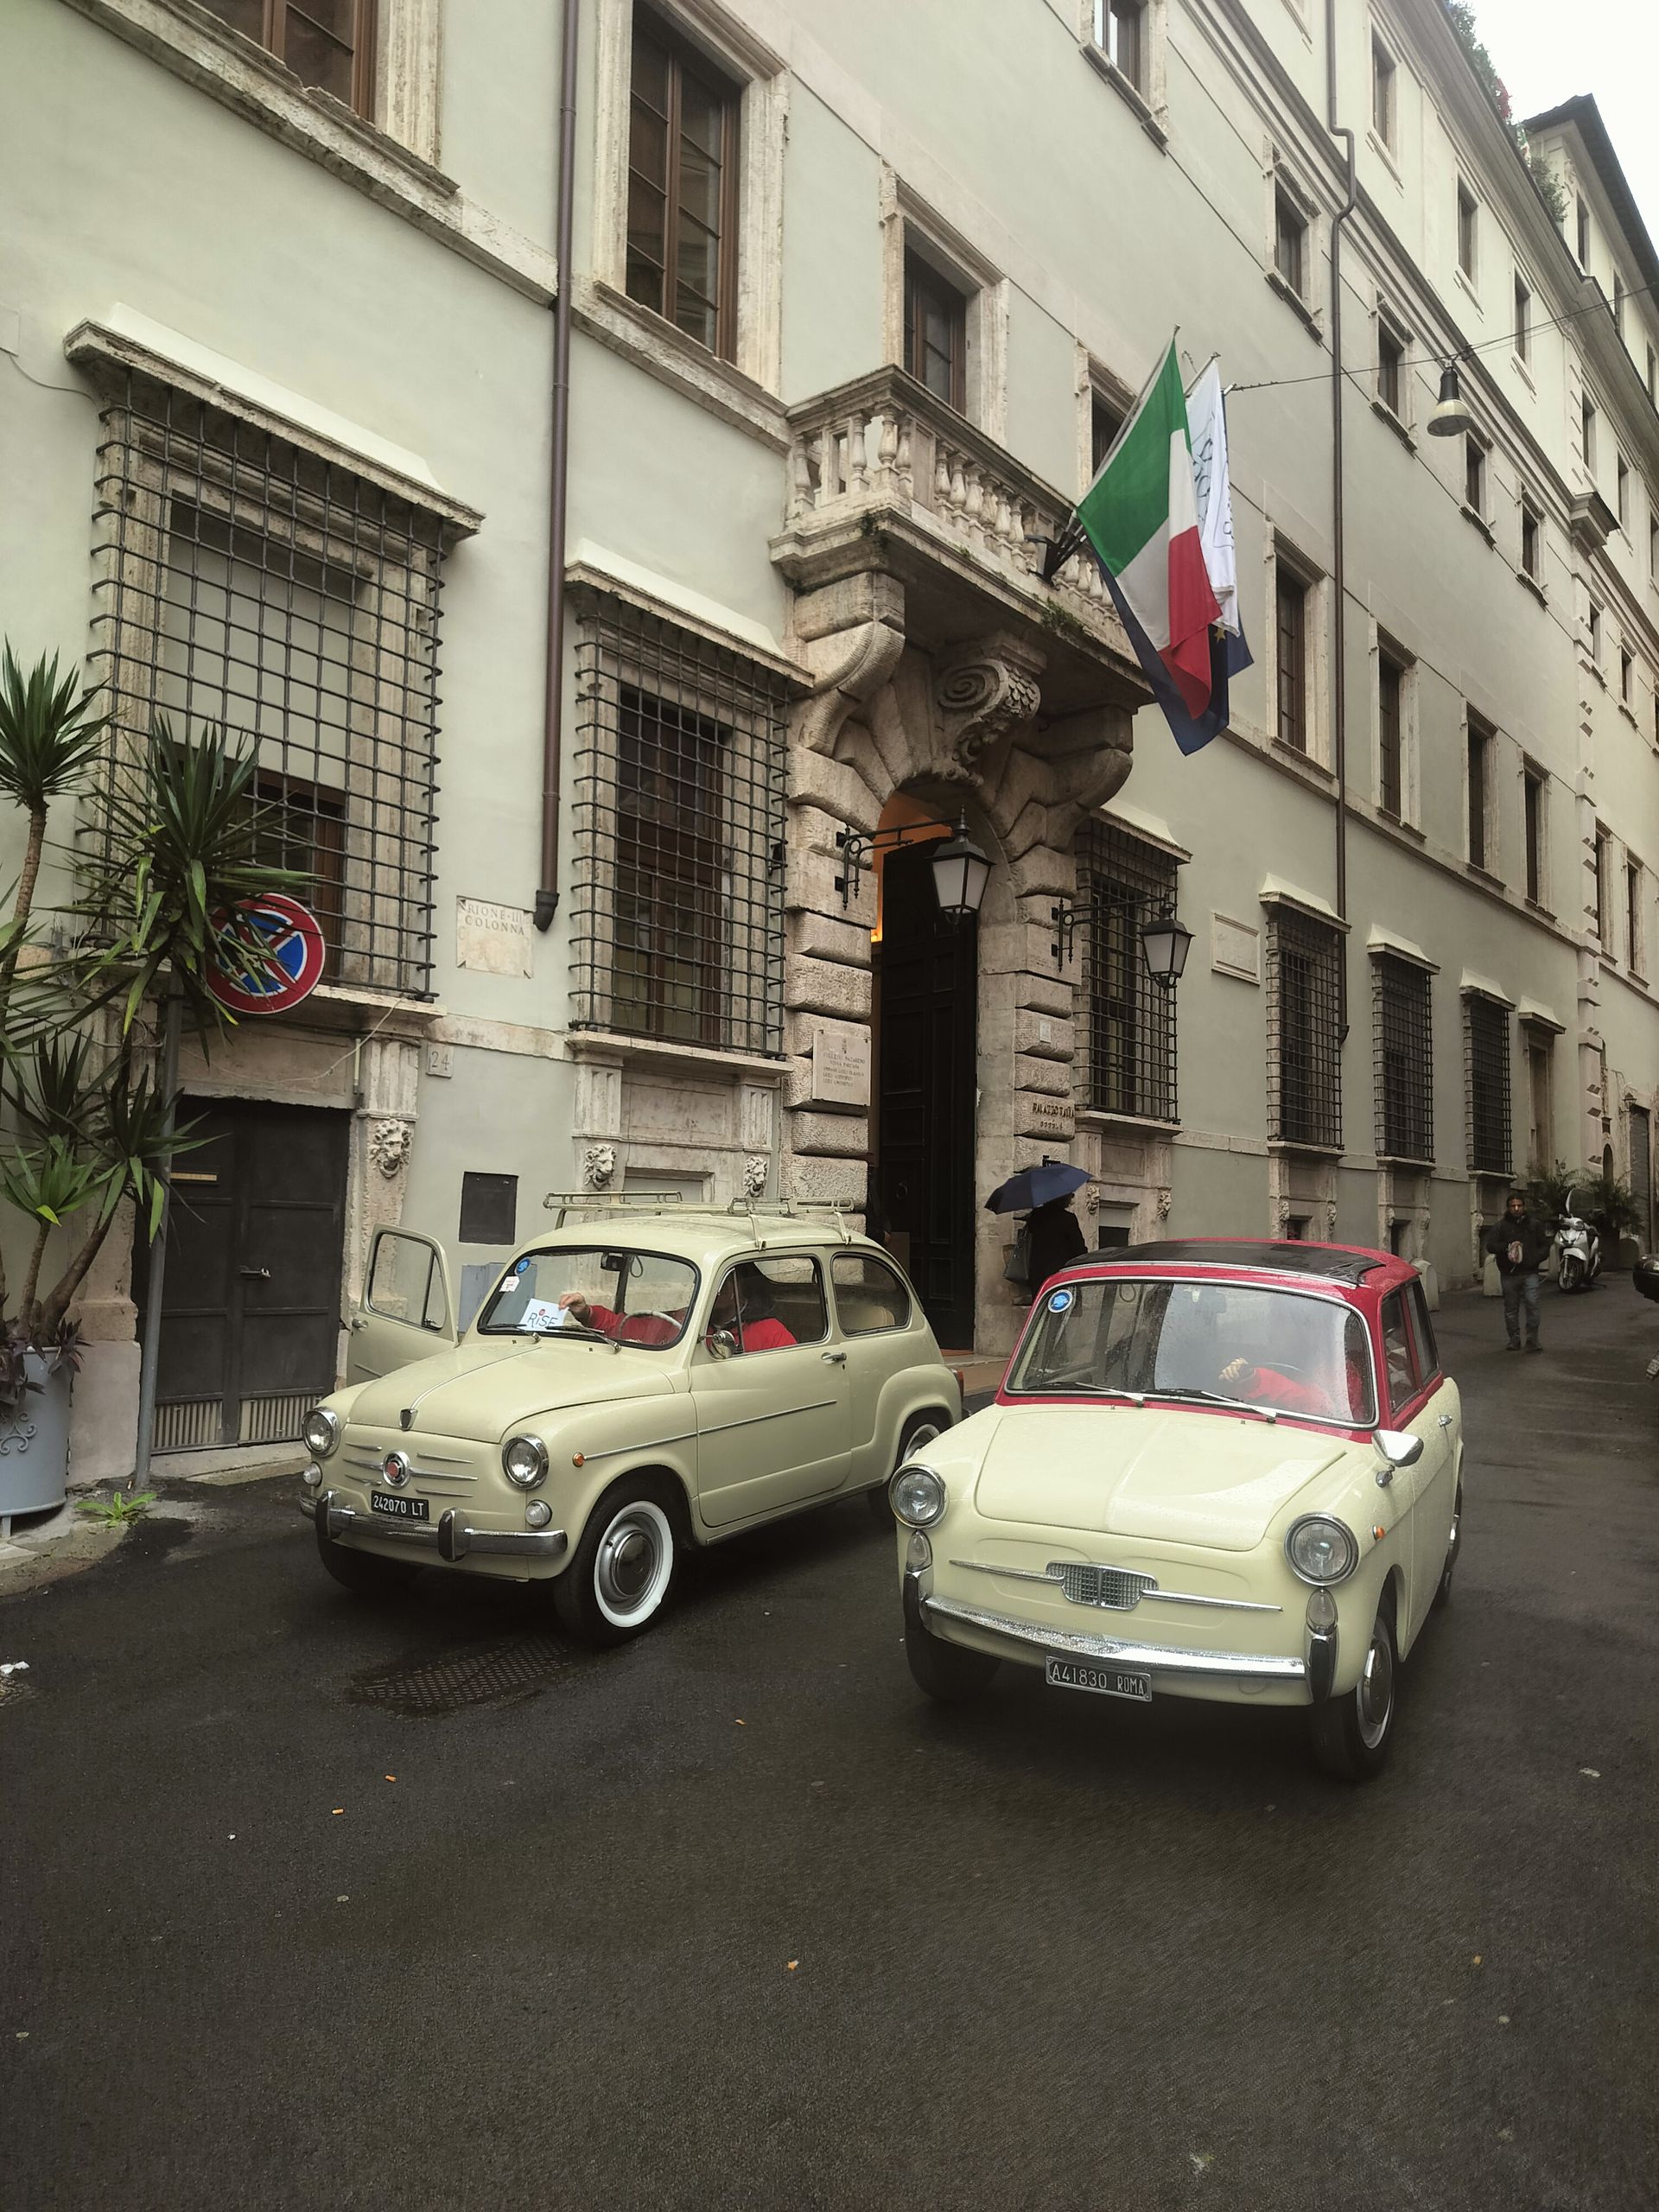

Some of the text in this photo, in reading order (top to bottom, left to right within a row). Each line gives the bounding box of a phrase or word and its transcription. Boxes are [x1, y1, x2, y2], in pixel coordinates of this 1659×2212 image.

[467, 904, 506, 920] RIONE
[465, 914, 524, 936] COLONNA
[431, 1050, 450, 1071] 24
[373, 1495, 424, 1516] 242070 LT
[1052, 1663, 1145, 1696] A41830 ROMA
